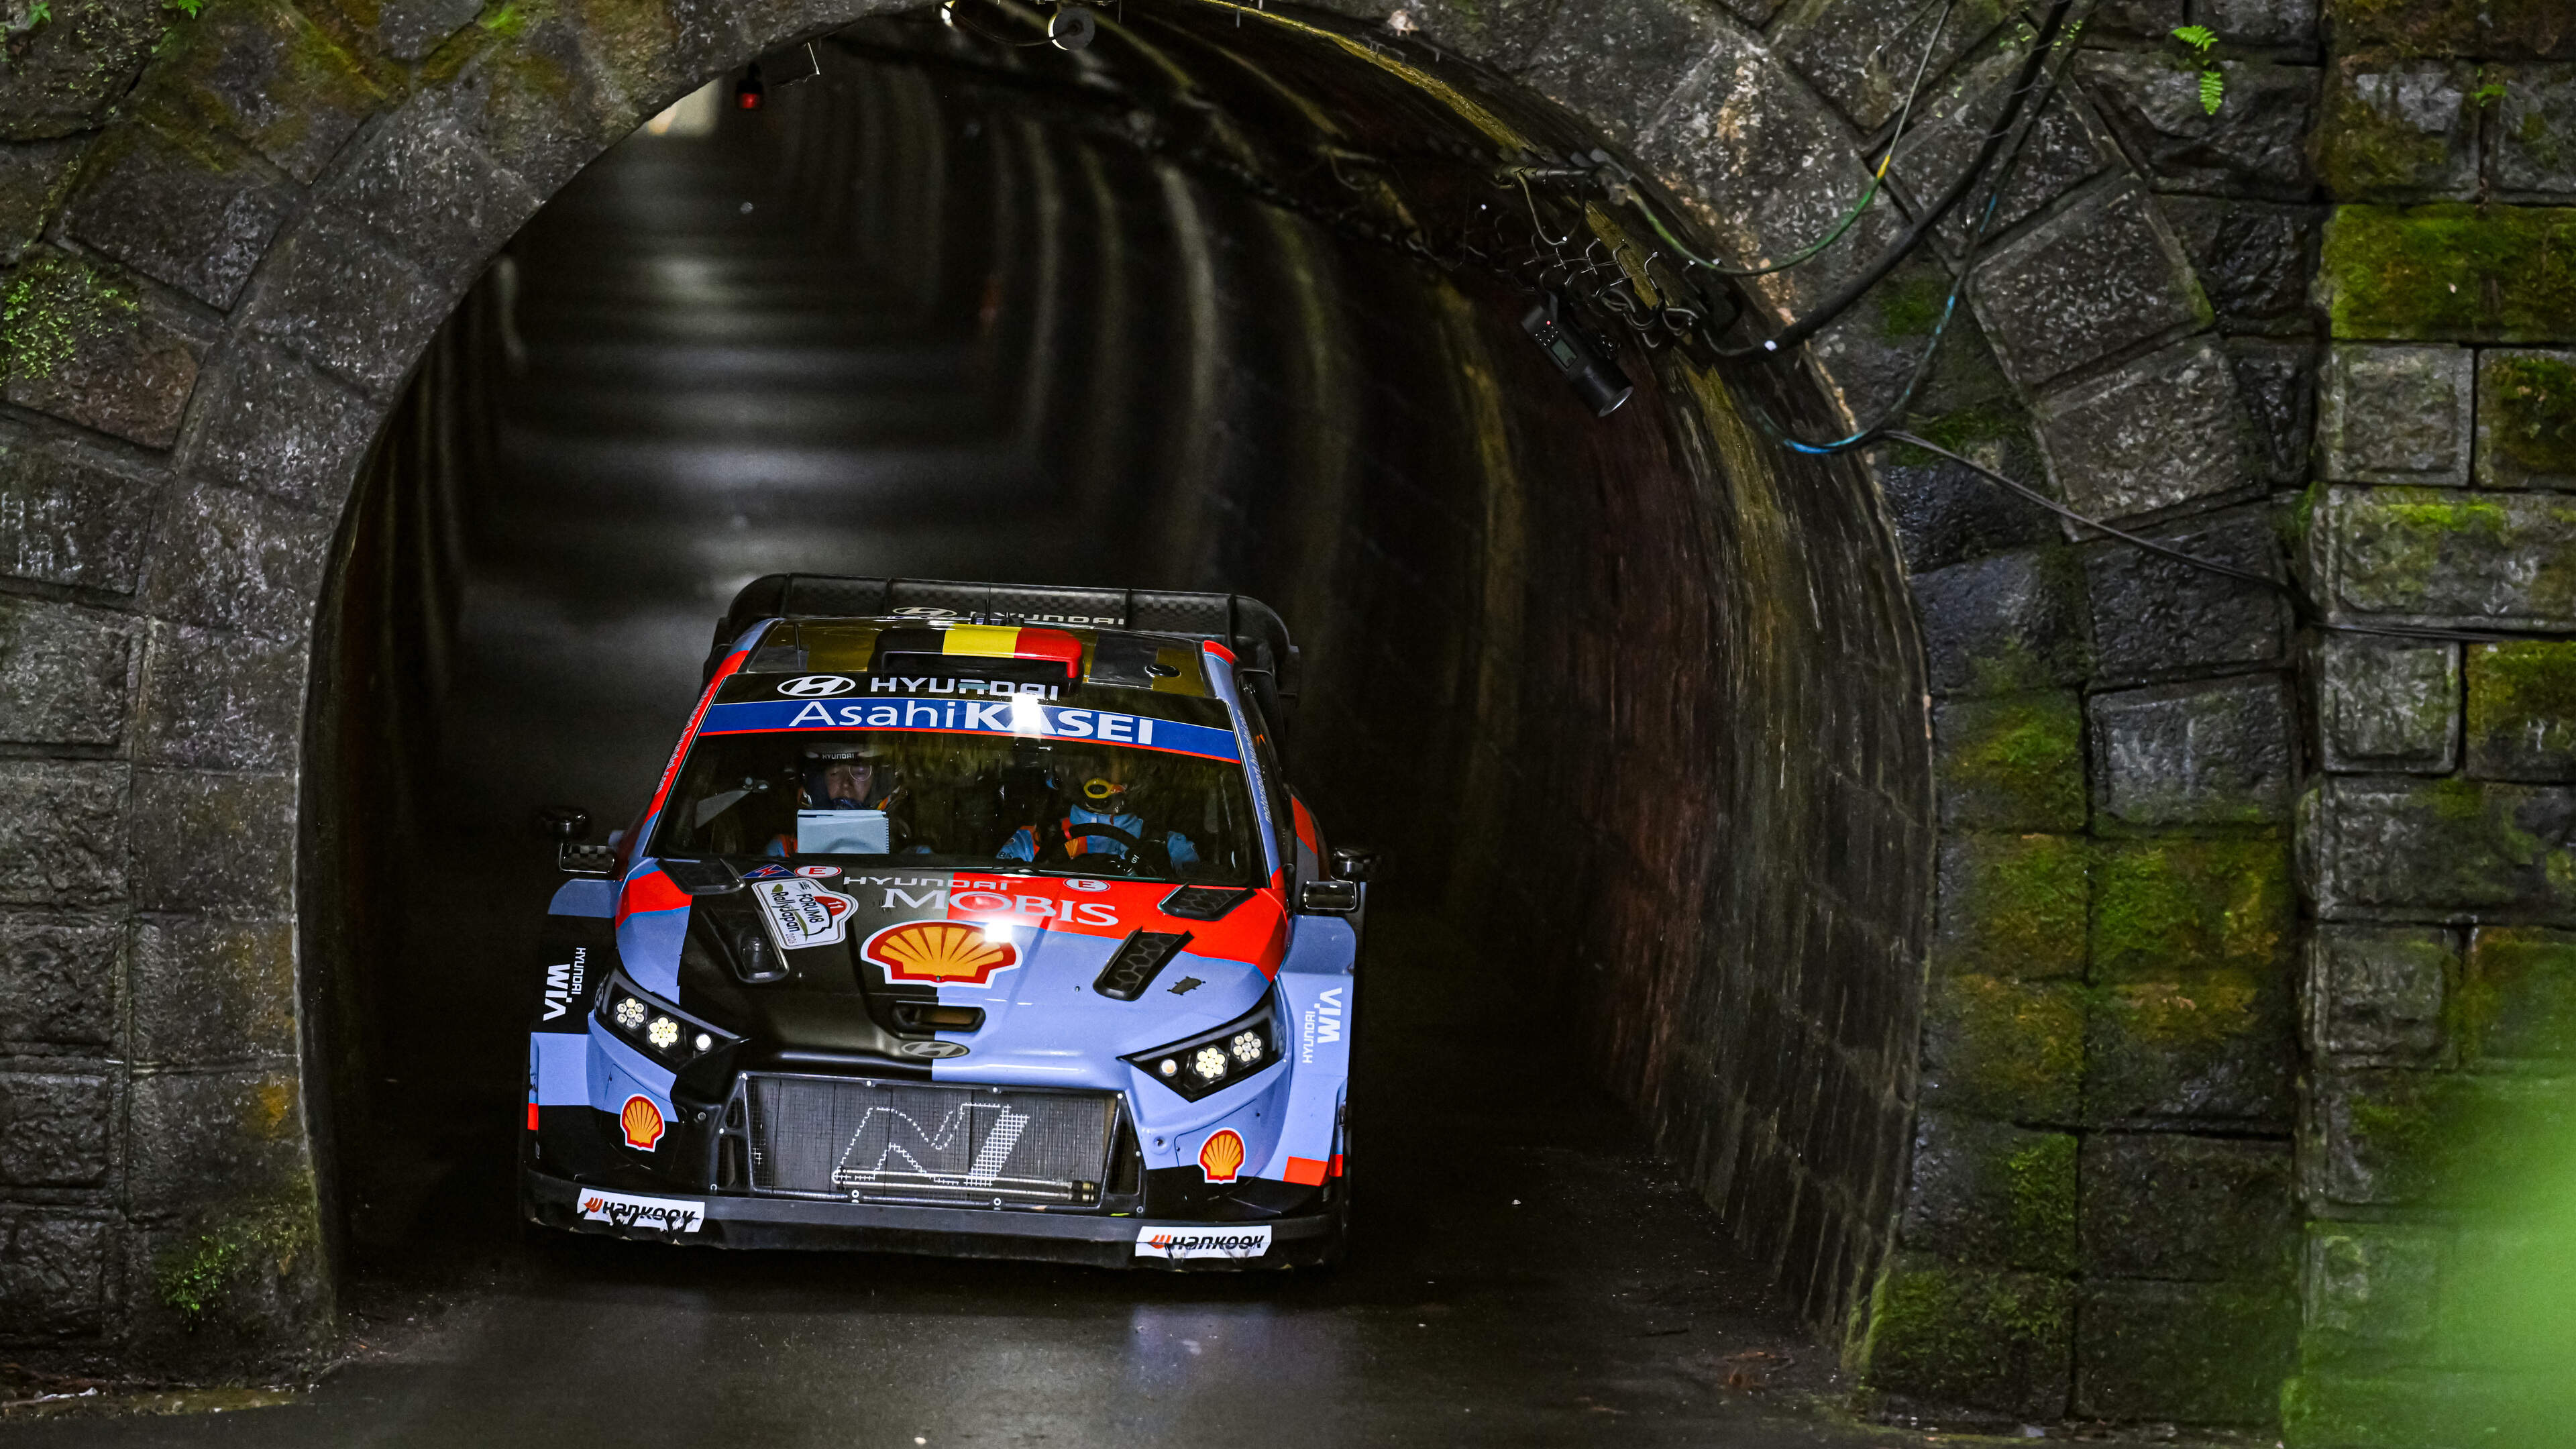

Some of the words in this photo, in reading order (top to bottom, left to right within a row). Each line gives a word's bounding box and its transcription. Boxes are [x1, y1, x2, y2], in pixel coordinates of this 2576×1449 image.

[971, 611, 1125, 625] UNDAI
[870, 677, 1059, 701] HYUNDAI
[843, 876, 1010, 890] HYUNDAI
[1078, 880, 1095, 889] E
[796, 893, 825, 924] FORUM8
[828, 901, 844, 909] 11
[880, 888, 1119, 927] MOBIS
[571, 947, 586, 995] HYUNDAI
[1302, 1010, 1316, 1063] HYUNDAI
